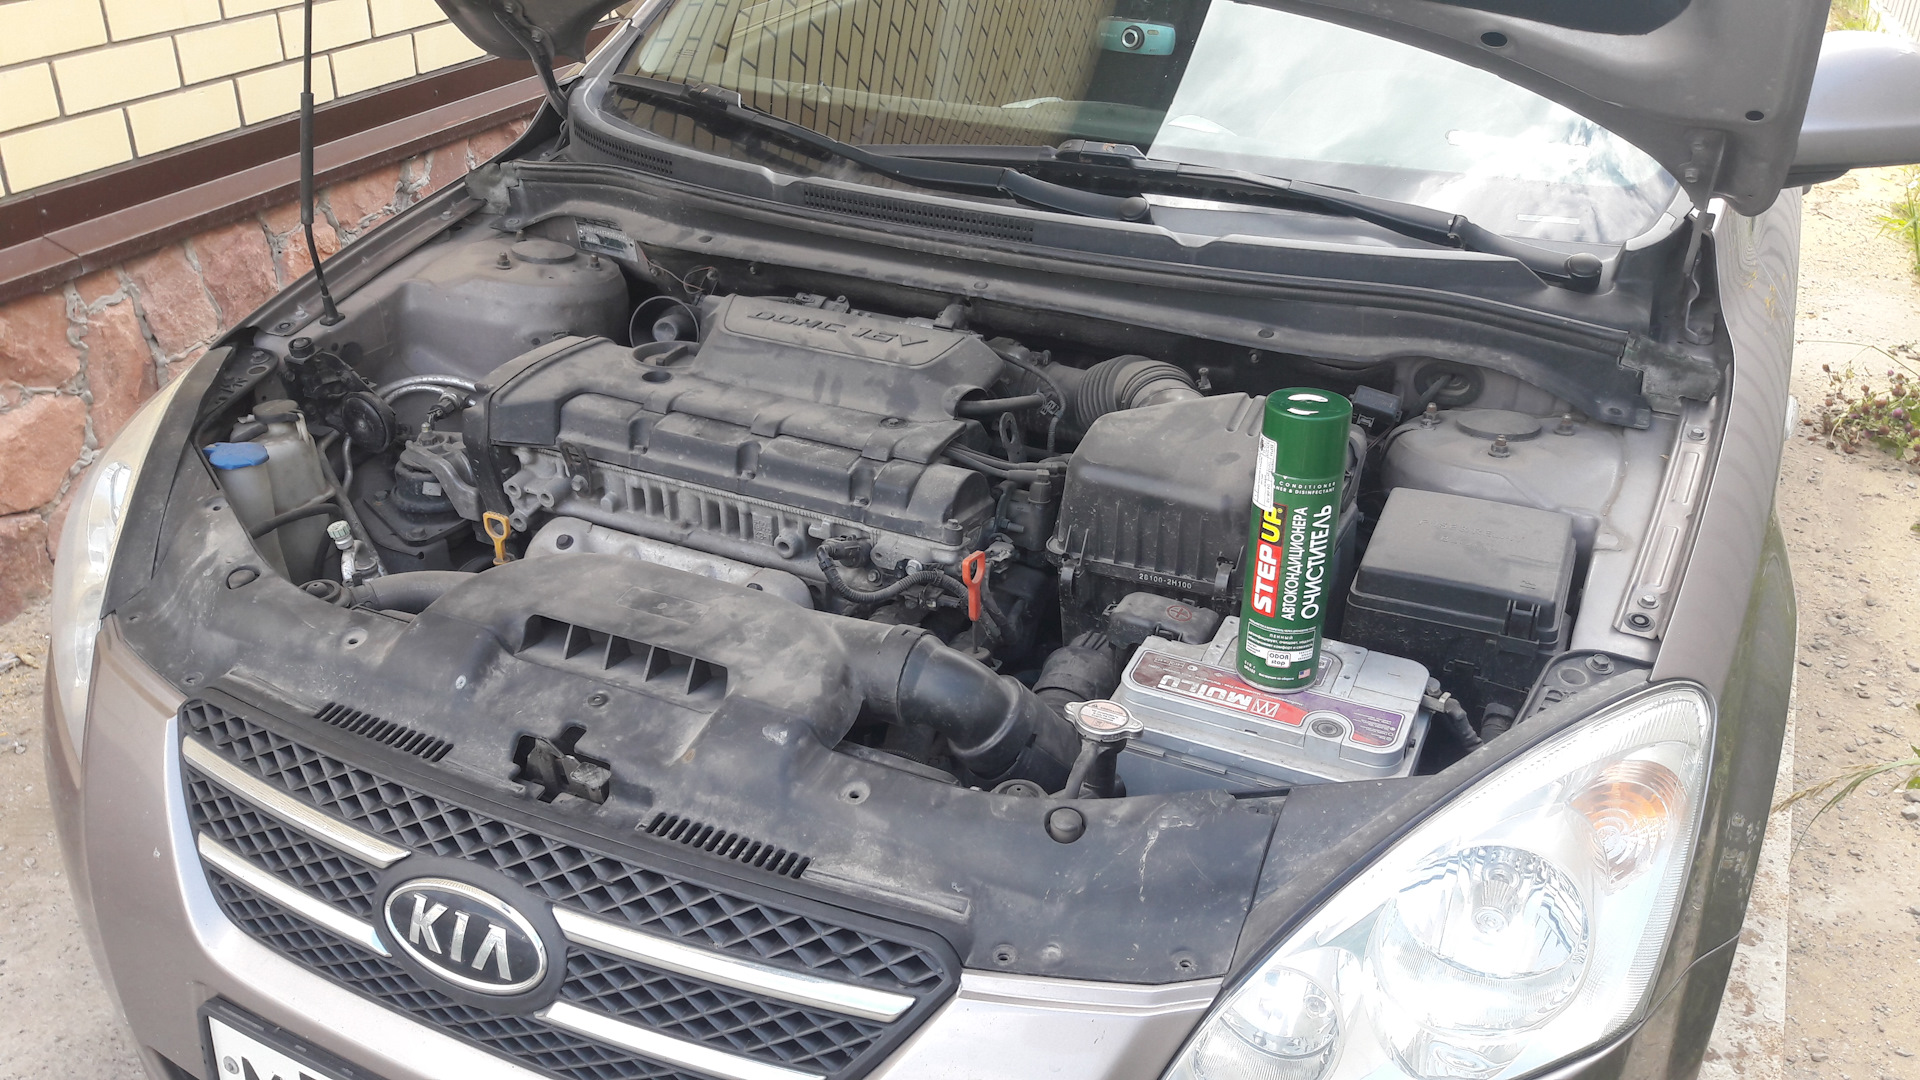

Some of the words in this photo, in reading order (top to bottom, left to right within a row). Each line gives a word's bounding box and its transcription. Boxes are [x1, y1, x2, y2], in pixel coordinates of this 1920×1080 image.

[748, 311, 846, 333] DOHC
[1279, 480, 1335, 490] CONDITIONER
[1261, 506, 1281, 543] UP
[1253, 543, 1277, 614] STEP
[1281, 507, 1309, 621] АВТОКОНДИЦИОНЕРА
[1301, 505, 1332, 619] ОЧИСТИТЕЛЬ
[409, 893, 512, 981] KIA
